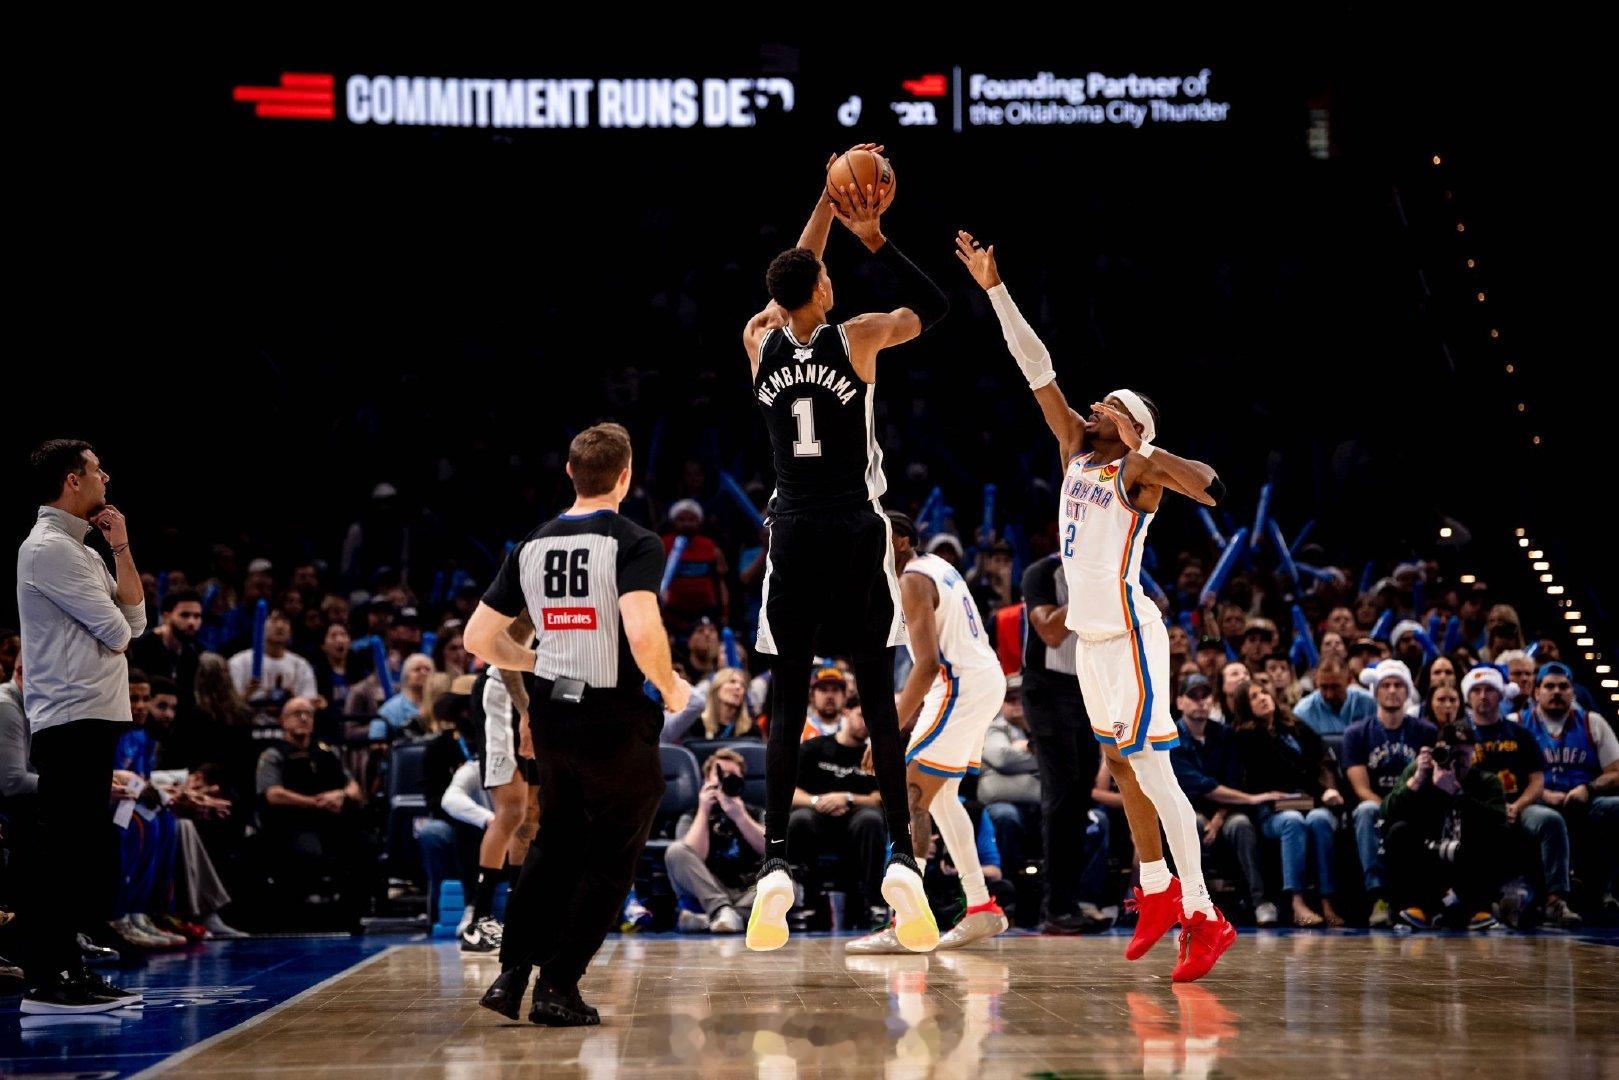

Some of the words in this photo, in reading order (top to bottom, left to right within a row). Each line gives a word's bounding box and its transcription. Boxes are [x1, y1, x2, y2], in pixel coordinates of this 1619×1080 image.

[346, 75, 593, 127] COMMITMENT
[599, 78, 699, 128] RUNS
[970, 71, 1085, 105] Founding
[1087, 72, 1180, 99] Partner
[1182, 68, 1210, 98] of
[970, 101, 1003, 125] the
[1004, 101, 1105, 125] Oklahoma
[1106, 100, 1147, 128] City
[1150, 99, 1229, 122] Thunder
[758, 363, 857, 407] WEMBANYAMA
[791, 397, 822, 458] 1
[1063, 522, 1077, 559] 2
[544, 548, 590, 598] 86
[547, 612, 592, 626] Emirates
